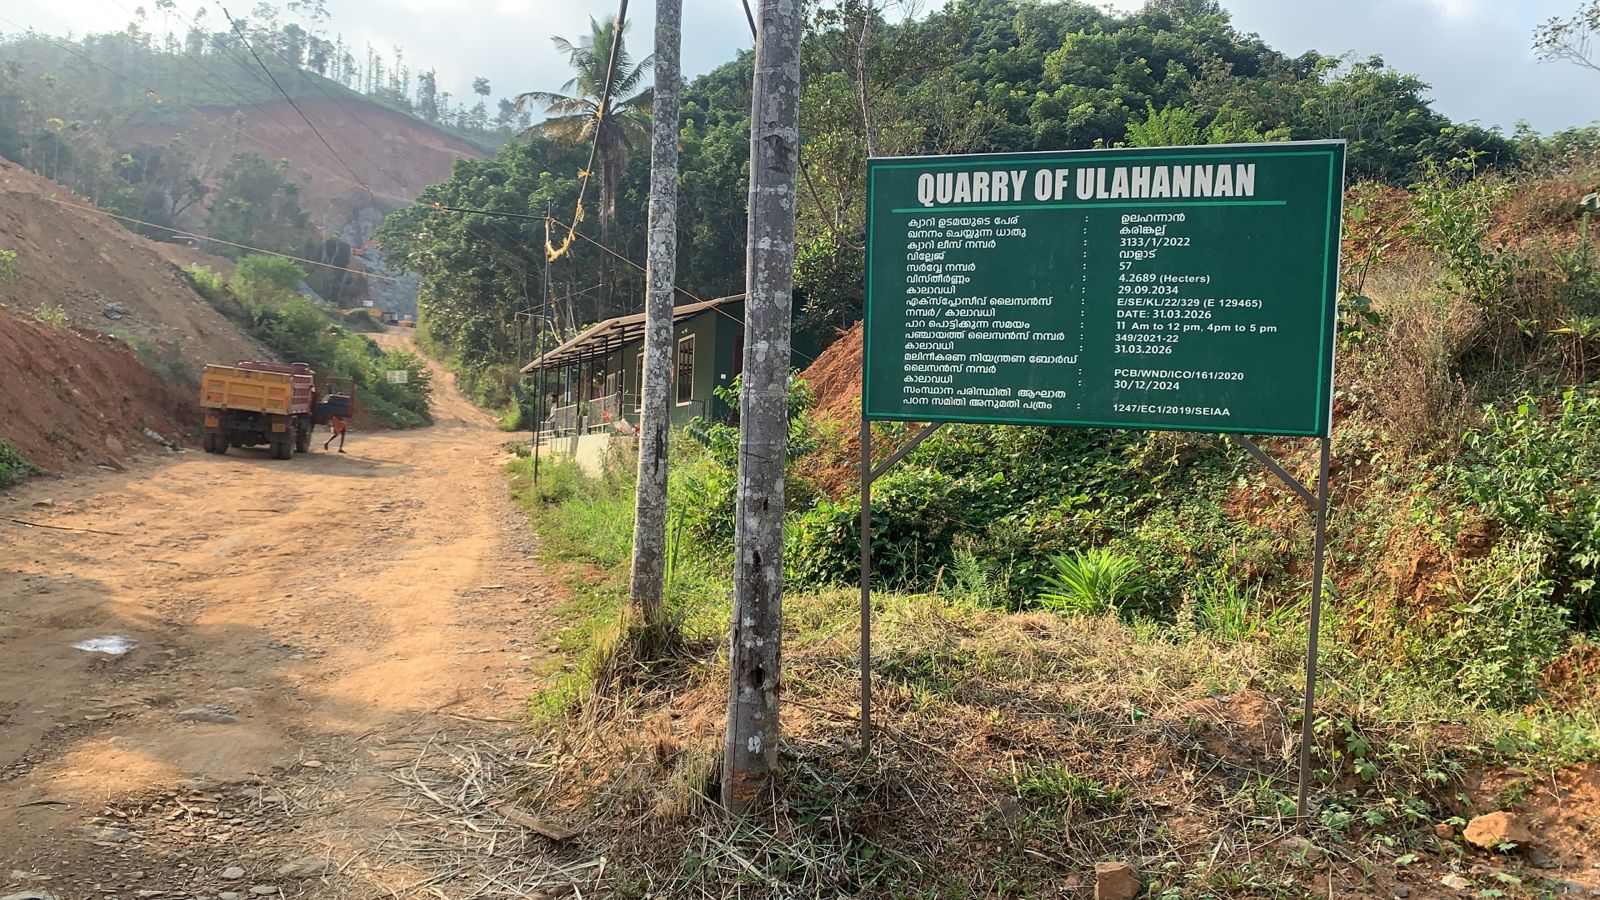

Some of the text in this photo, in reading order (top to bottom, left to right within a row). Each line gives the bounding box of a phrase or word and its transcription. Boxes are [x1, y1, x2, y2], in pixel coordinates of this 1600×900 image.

[917, 163, 1256, 207] QUARRY OF ULAHANNAN
[907, 217, 936, 229] ക്വാറി
[937, 216, 991, 228] ഉടമയുടെ
[993, 215, 1020, 225] പേര്
[1120, 212, 1186, 225] ഉലഹന്നാൻ
[907, 229, 943, 239] ഖനനം
[945, 228, 993, 239] ചെയ്യുന്ന
[995, 227, 1027, 239] ധാതു
[1119, 224, 1168, 237] കരിങ്കല്ല്
[906, 239, 936, 252] ക്വാറി
[936, 238, 963, 250] ലീസ്
[964, 238, 997, 249] നമ്പർ
[1119, 236, 1191, 248] 3133/1/2022
[1118, 248, 1158, 261] വാളാട്
[945, 262, 977, 273] നമ്പർ
[1118, 261, 1133, 271] 57
[1118, 273, 1157, 283] 4.2689
[1159, 274, 1211, 284] (Hecters)
[905, 284, 956, 295] കാലാവധി
[1117, 285, 1179, 295] 29.09.2034
[989, 296, 1054, 307] ലൈസൻസ്
[1116, 297, 1201, 307] E/SE/KL/22/329
[1203, 298, 1216, 308] (E
[1218, 298, 1263, 309] 129465)
[944, 307, 996, 317] കാലാവധി
[1116, 309, 1150, 319] DATE:
[1152, 309, 1212, 320] 31.03.2026
[905, 319, 926, 328] പാറ
[991, 320, 1031, 329] സമയം
[1115, 320, 1126, 330] 11
[1131, 321, 1150, 331] Am
[1152, 322, 1164, 331] to
[1167, 322, 1180, 331] 12
[1182, 324, 1204, 333] pm,
[1206, 323, 1232, 333] 4pm
[1234, 323, 1246, 332] to
[1249, 323, 1257, 333] 5
[1259, 325, 1278, 334] pm
[967, 330, 1031, 341] ലൈസൻസ്
[1032, 331, 1066, 341] നമ്പർ
[1114, 333, 1179, 343] 349/2021-22
[904, 341, 954, 351] കാലാവധി
[1113, 344, 1173, 355] 31.03.2026
[1028, 354, 1079, 365] ബോർഡ്
[903, 363, 964, 374] ലൈസൻസ്
[965, 364, 997, 374] നമ്പർ
[1114, 368, 1245, 381] PCB/WND/ICO/161/2020
[903, 374, 953, 384] കാലാവധി
[1113, 379, 1180, 391] 30/12/2024
[902, 385, 954, 395] സംസ്ഥാന
[1017, 389, 1067, 399] ആഘാത
[902, 396, 929, 405] പഠന
[931, 397, 966, 407] സമിതി
[968, 398, 1020, 410] അനുമതി
[1022, 400, 1053, 410] പത്രം
[1112, 403, 1231, 417] 1247/EC1/2019/SEIAA
